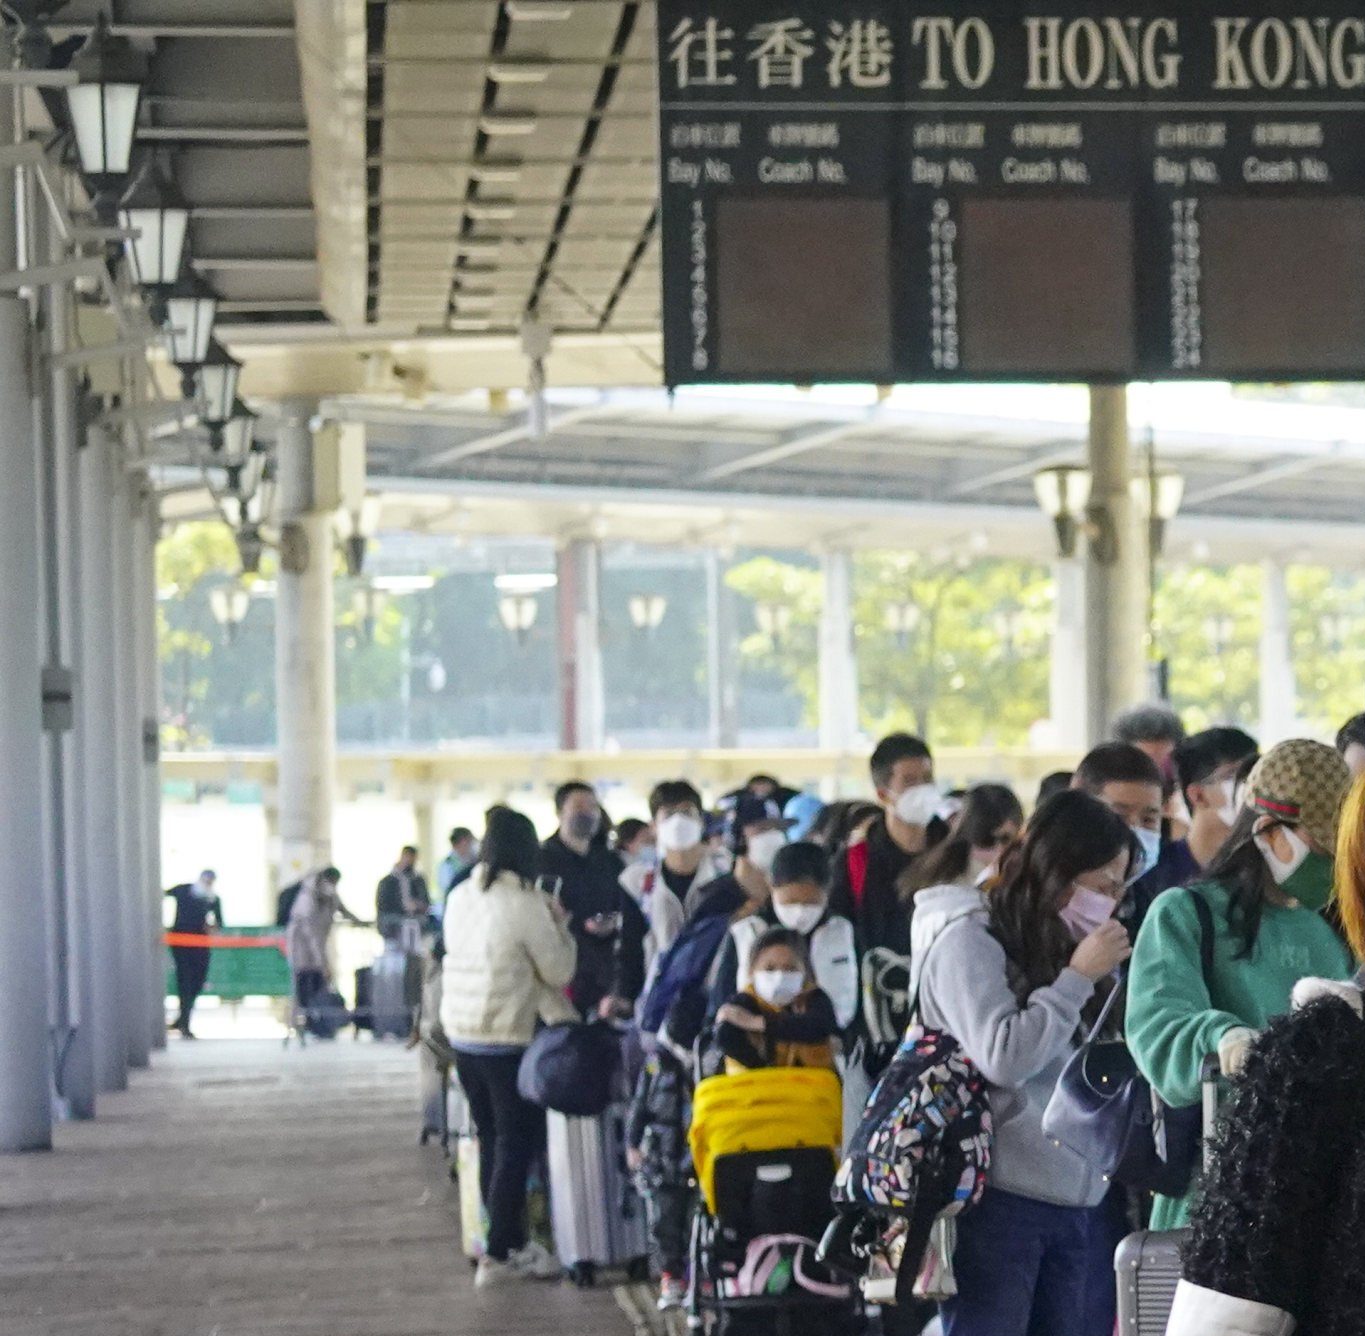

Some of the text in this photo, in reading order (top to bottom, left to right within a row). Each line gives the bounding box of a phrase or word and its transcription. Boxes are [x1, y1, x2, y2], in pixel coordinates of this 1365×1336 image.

[668, 18, 894, 89] 往香港
[913, 18, 995, 90] TO
[1025, 18, 1181, 90] HONG
